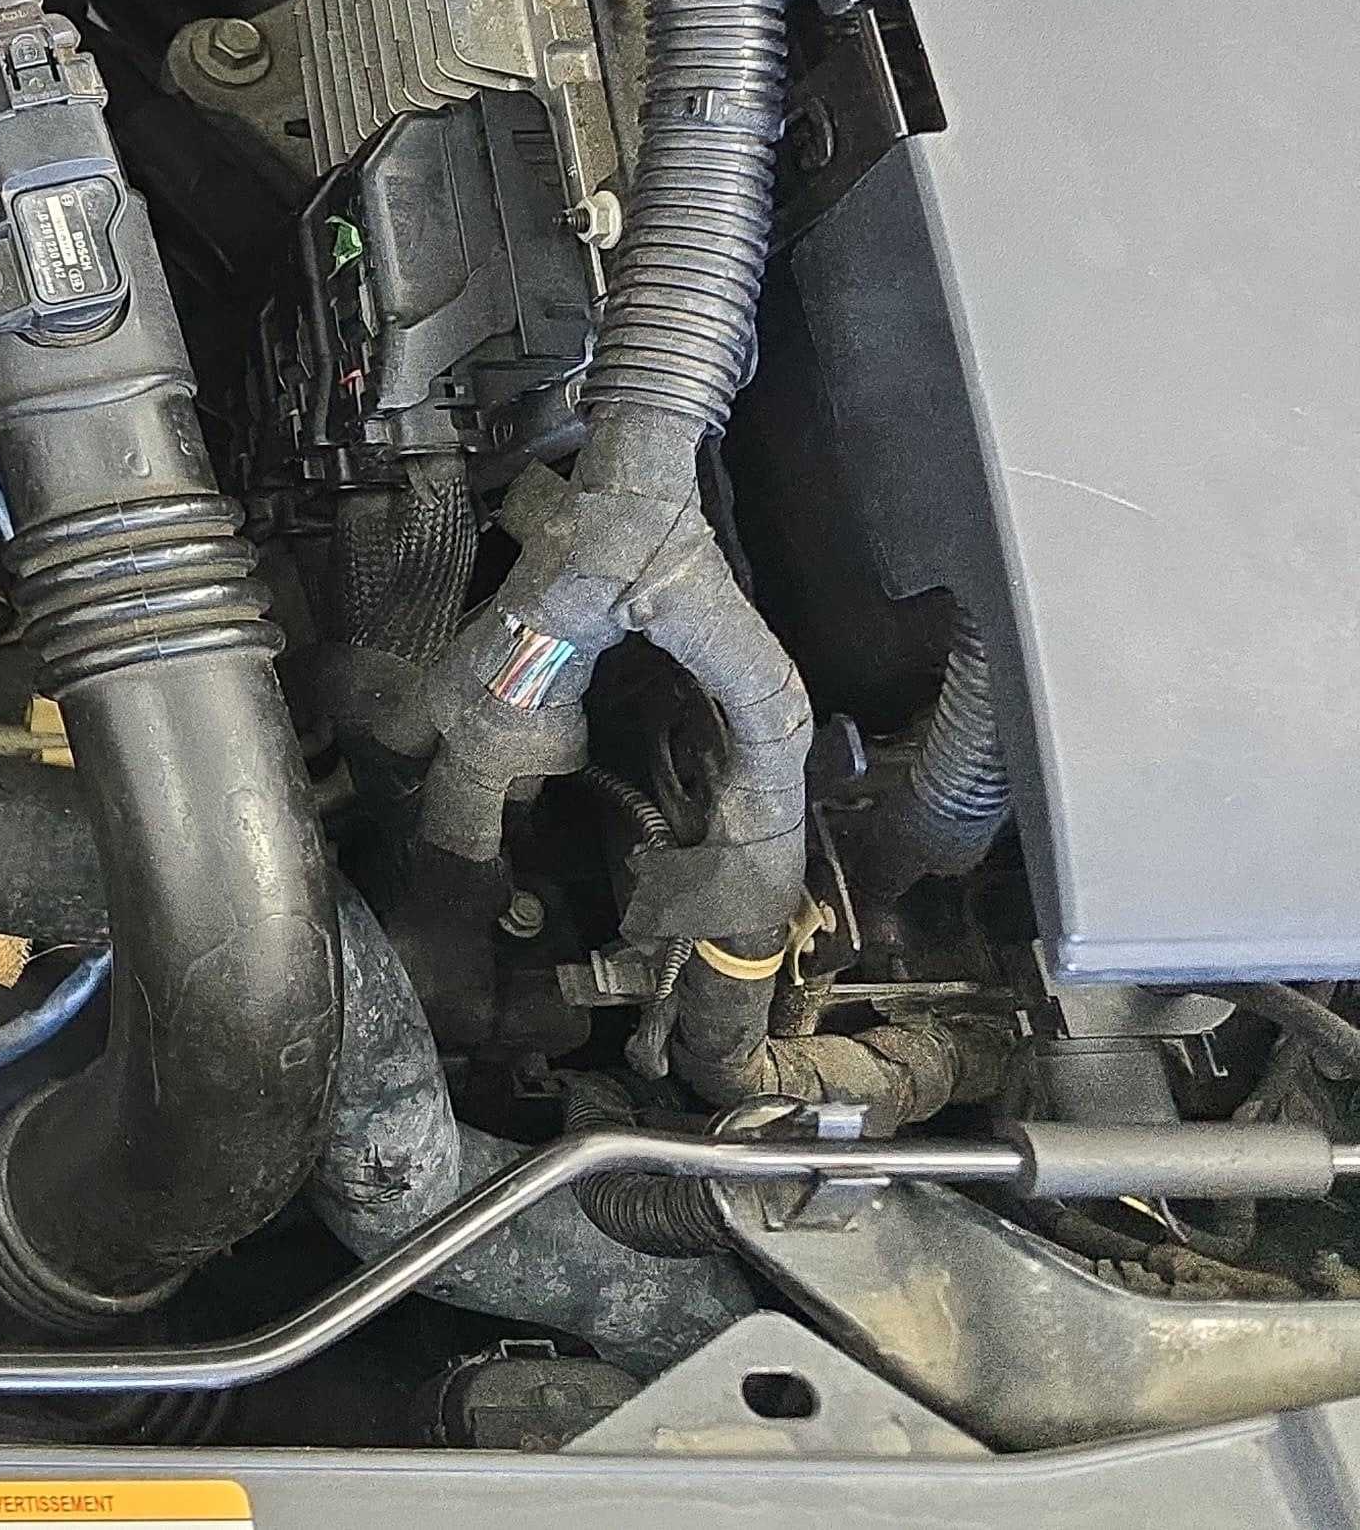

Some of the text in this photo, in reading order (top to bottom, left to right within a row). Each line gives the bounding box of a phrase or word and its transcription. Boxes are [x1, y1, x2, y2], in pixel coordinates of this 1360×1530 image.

[46, 241, 60, 259] 230
[72, 231, 93, 271] BOSCH
[52, 260, 67, 279] 042
